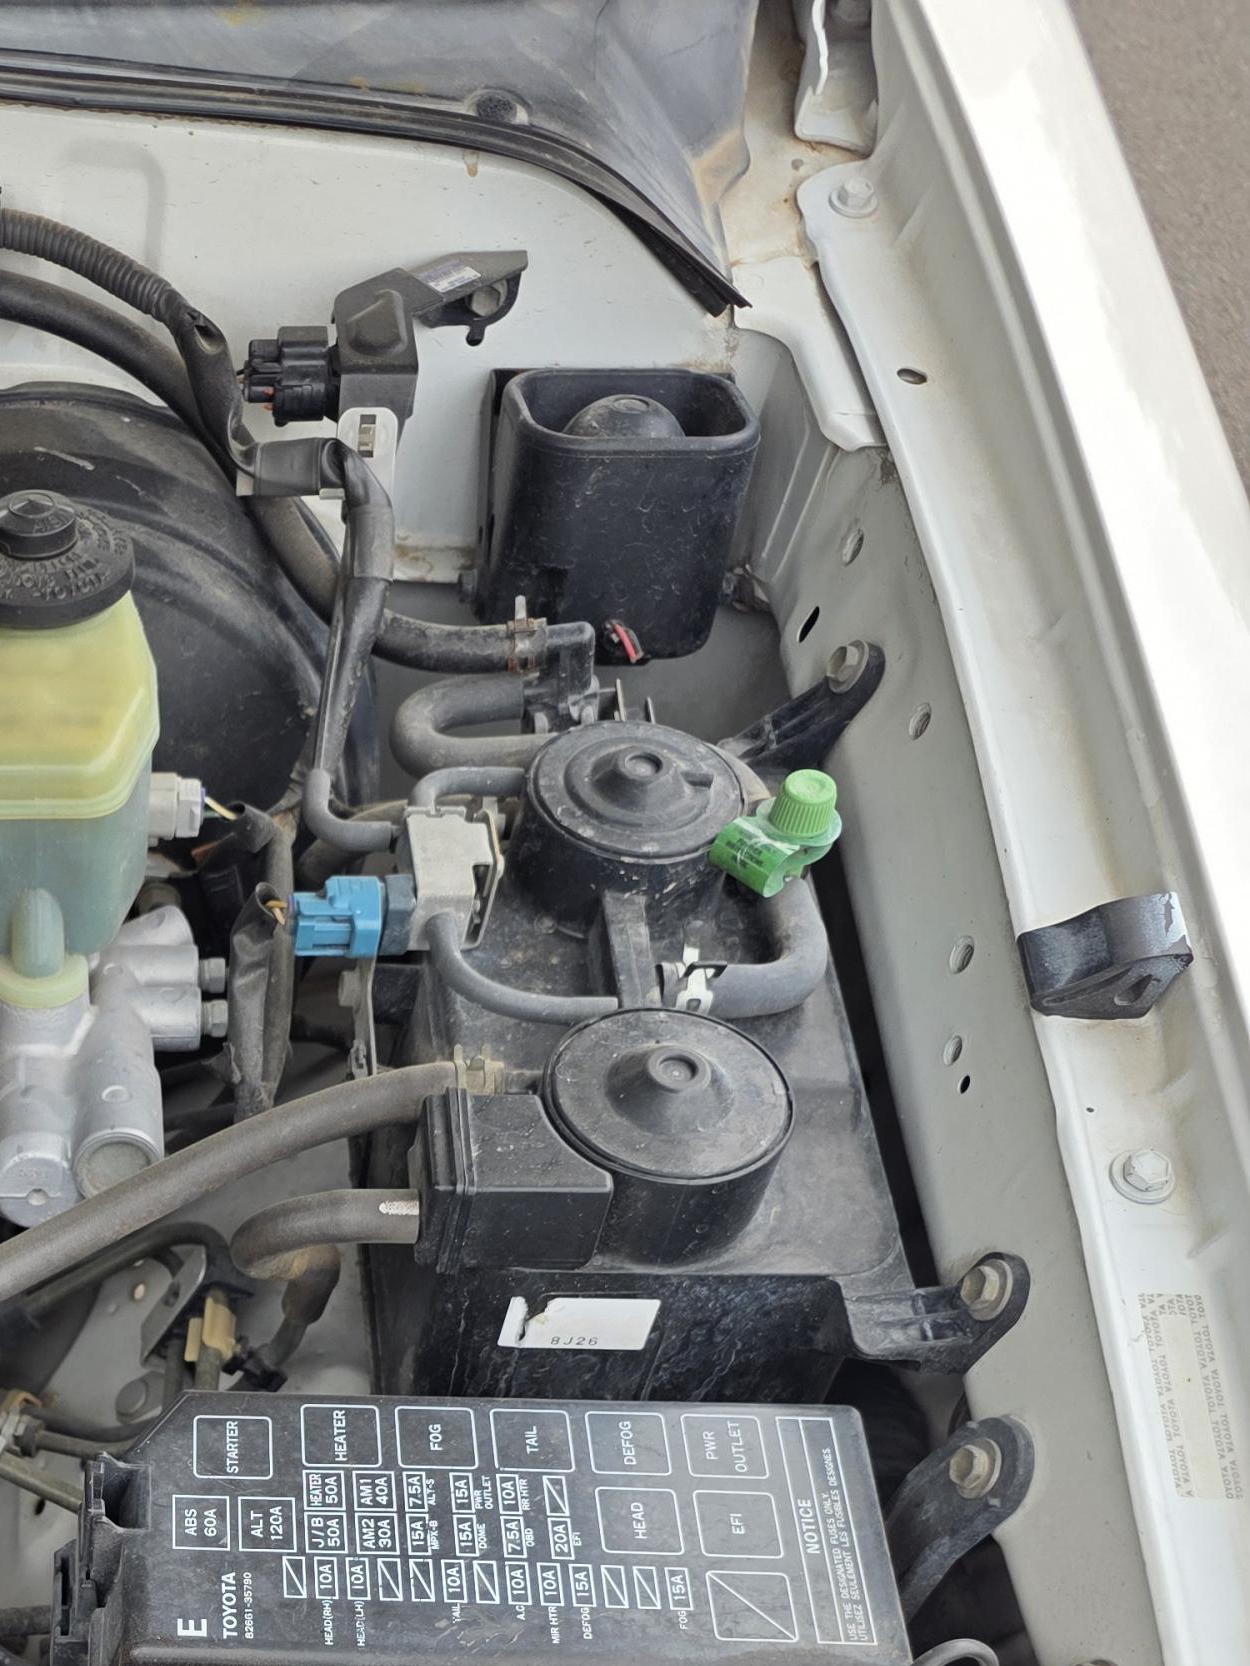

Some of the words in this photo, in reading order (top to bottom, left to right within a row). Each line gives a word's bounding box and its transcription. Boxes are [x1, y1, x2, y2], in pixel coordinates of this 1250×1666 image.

[550, 1336, 598, 1346] 8J26
[1194, 1331, 1208, 1369] TOYOTA
[1202, 1324, 1216, 1362] TOYOTA
[227, 1421, 239, 1473] STARTER
[333, 1410, 347, 1461] HEATER
[429, 1424, 442, 1451] FOG
[526, 1426, 539, 1454] TAIL
[619, 1421, 637, 1464] DEFOG
[702, 1431, 719, 1460] PWR
[727, 1421, 748, 1472] OUTLET
[310, 1473, 322, 1506] HEATER
[326, 1476, 338, 1504] 50A
[360, 1478, 374, 1505] AM1
[375, 1477, 388, 1504] 40A
[407, 1477, 422, 1507] 7.5A
[426, 1479, 436, 1505] ALT-S
[454, 1479, 468, 1505] 15A
[475, 1489, 484, 1509] PWR
[482, 1475, 494, 1509] OUTLET
[501, 1480, 516, 1505] 10A
[519, 1479, 529, 1494] HTR
[521, 1495, 531, 1511] RR
[830, 1489, 847, 1527] FUSIBLES
[185, 1508, 197, 1536] ABS
[204, 1508, 217, 1537] 60A
[251, 1510, 264, 1538] ALT
[270, 1506, 283, 1540] 120A
[328, 1518, 340, 1547] 50A
[362, 1518, 376, 1549] AM2
[377, 1519, 391, 1548] 30A
[410, 1520, 425, 1547] 15A
[429, 1520, 440, 1549] MPX-B
[457, 1520, 472, 1547] 15A
[630, 1502, 648, 1539] HEAD
[729, 1513, 746, 1535] EFI
[798, 1498, 821, 1553] NOTICE
[825, 1518, 839, 1544] FUSES
[478, 1523, 488, 1549] DOME
[506, 1520, 522, 1552] 7.5A
[525, 1528, 535, 1547] OBD
[554, 1524, 569, 1553] 20A
[572, 1532, 582, 1546] EFI
[838, 1531, 850, 1547] LES
[319, 1564, 332, 1591] 10A
[351, 1565, 364, 1590] 10A
[447, 1565, 462, 1593] 10A
[511, 1568, 526, 1595] 10A
[544, 1569, 559, 1596] 10A
[574, 1571, 589, 1597] 15A
[670, 1574, 686, 1600] 15A
[831, 1547, 851, 1599] DESIGNATED
[842, 1549, 861, 1600] SEULEMENT
[222, 1572, 238, 1639] TOYOTA
[243, 1572, 254, 1639] 82661-35790
[548, 1606, 559, 1626] HTR
[841, 1603, 854, 1619] THE
[177, 1618, 208, 1637] E
[322, 1600, 334, 1645] HEAD(RH)
[354, 1600, 366, 1647] HEAD(LH)
[581, 1607, 593, 1639] DEFOG
[679, 1610, 689, 1630] FOG
[846, 1623, 858, 1641] USE
[853, 1604, 869, 1641] UTILISEZ
[551, 1627, 561, 1644] MIR
